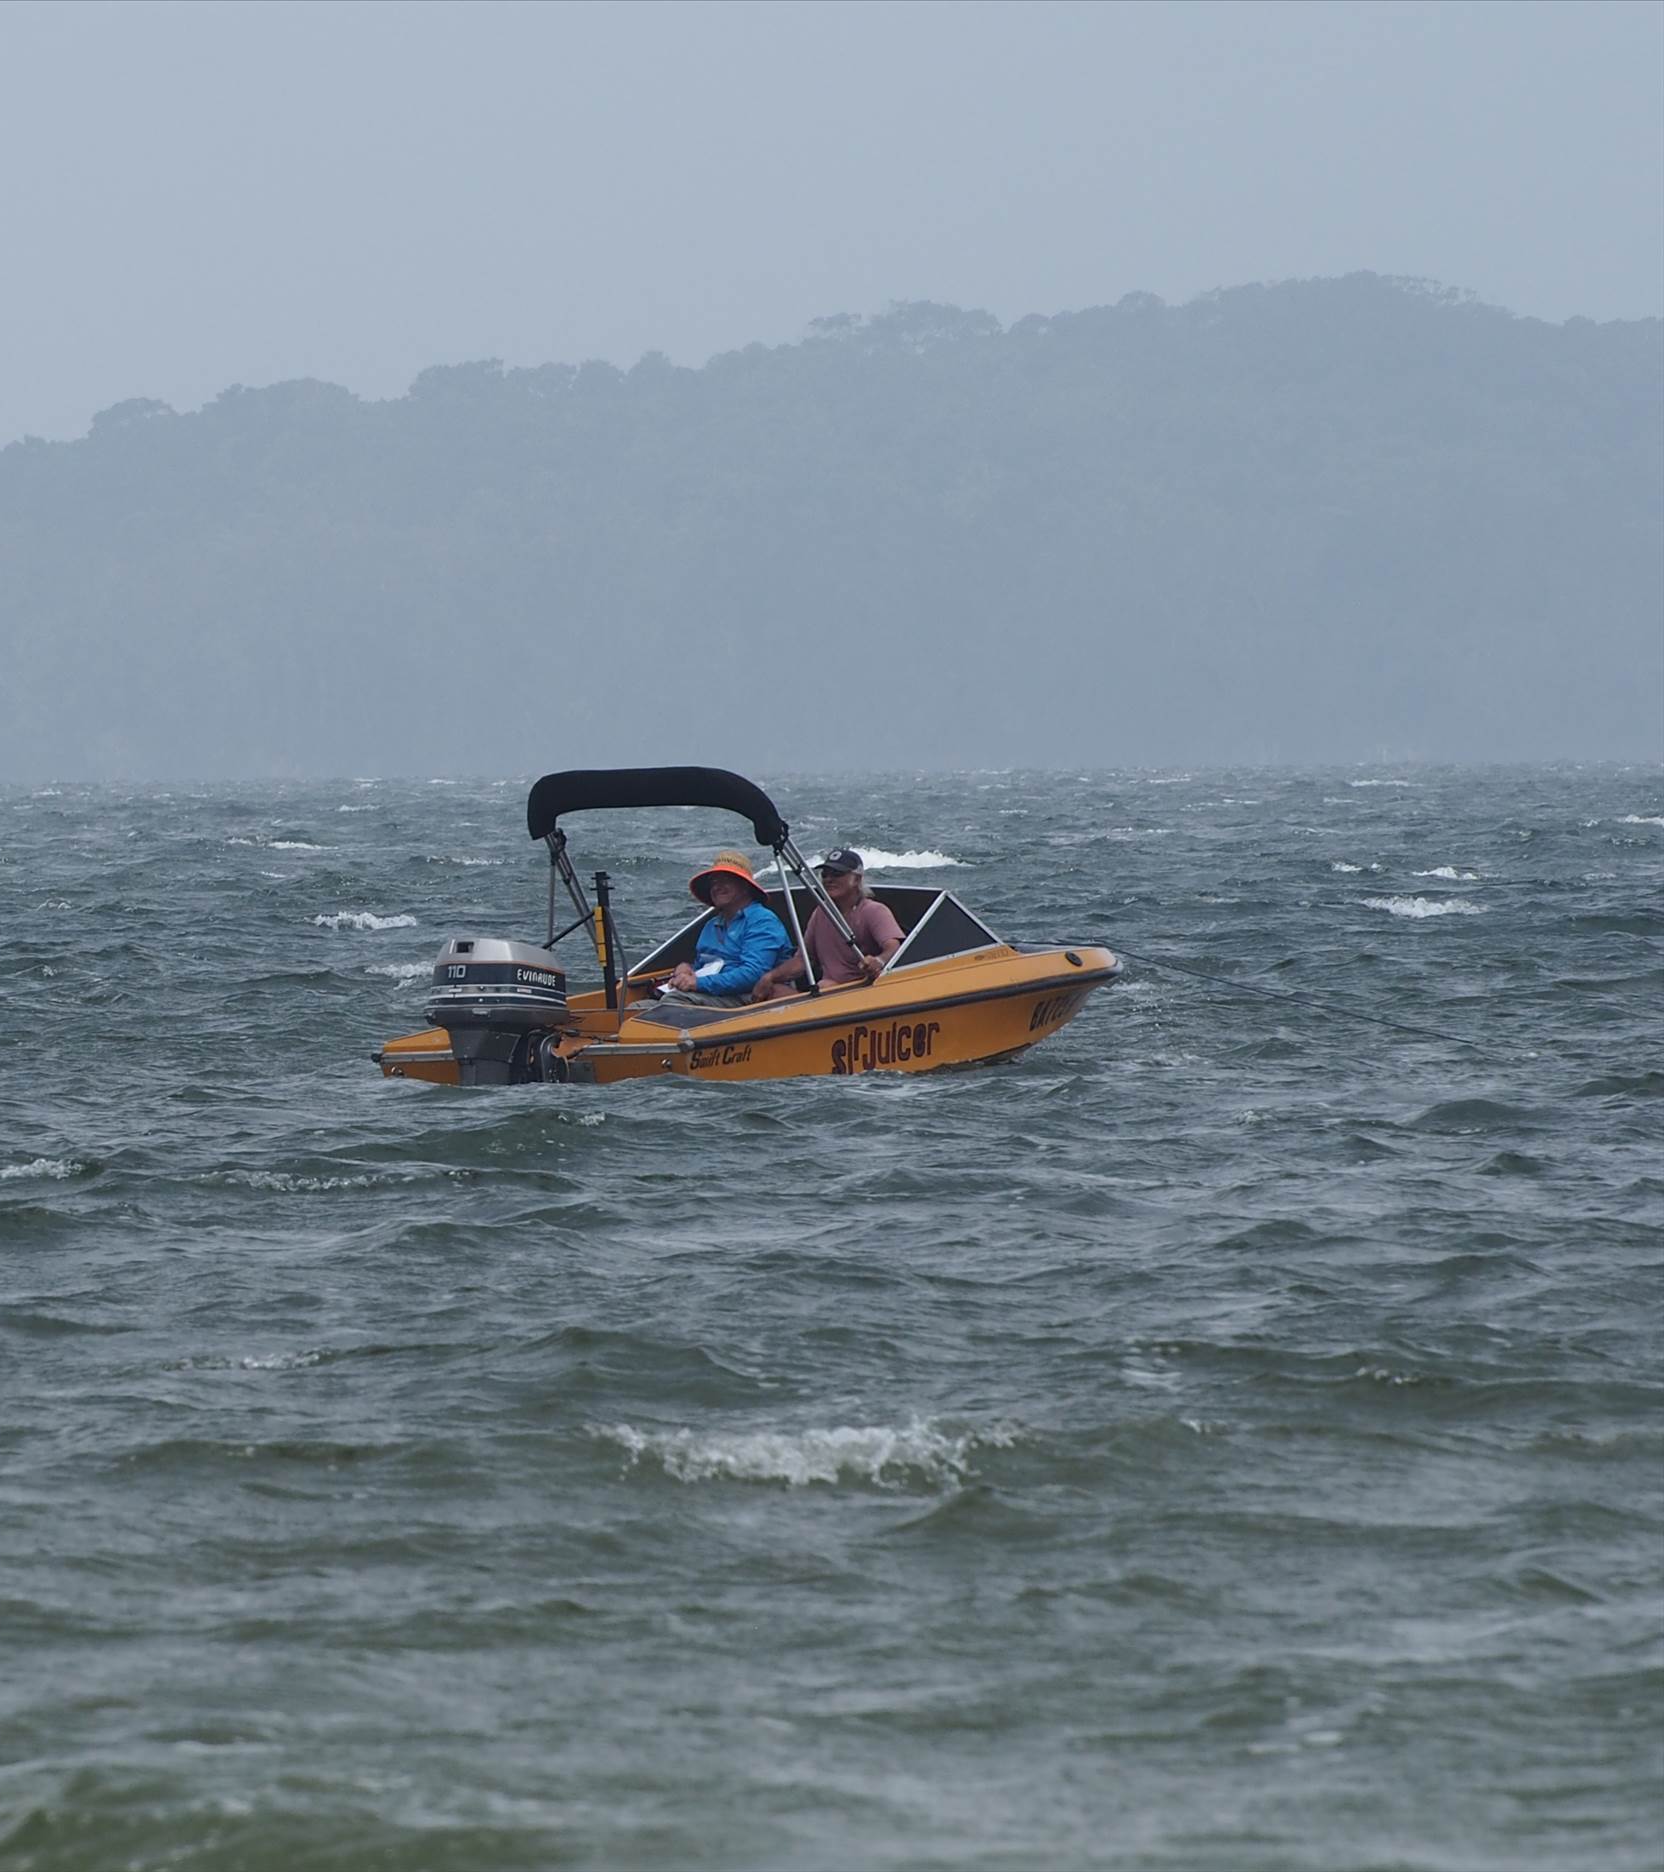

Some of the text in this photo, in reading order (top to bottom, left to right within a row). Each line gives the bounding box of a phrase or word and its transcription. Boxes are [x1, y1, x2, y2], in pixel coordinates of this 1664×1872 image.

[447, 964, 467, 979] 110
[516, 968, 557, 987] EVINRUDE
[721, 1043, 753, 1065] Craft
